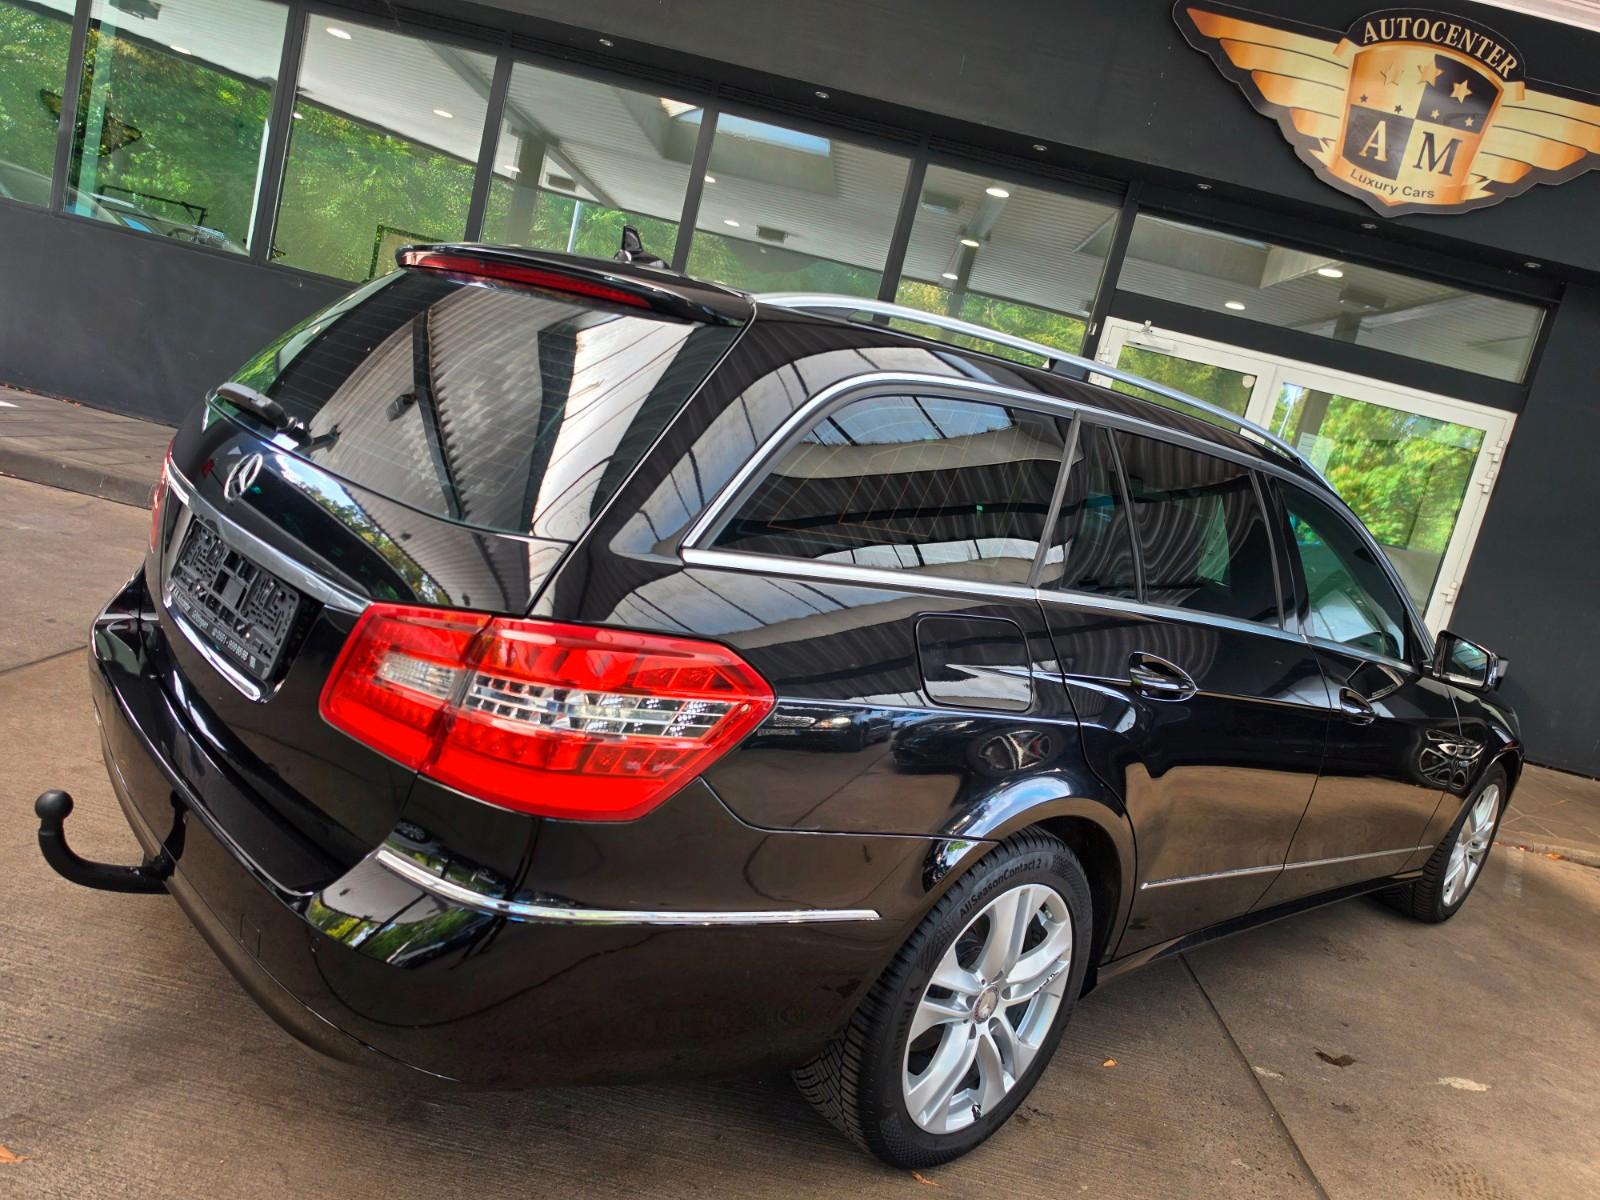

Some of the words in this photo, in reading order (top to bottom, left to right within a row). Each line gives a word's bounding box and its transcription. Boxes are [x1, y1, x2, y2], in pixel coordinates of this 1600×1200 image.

[1363, 16, 1518, 79] AUTOCENTER
[1359, 120, 1388, 162] A
[1413, 131, 1463, 177] M
[1350, 167, 1398, 197] Luxury
[1402, 186, 1436, 199] Cars
